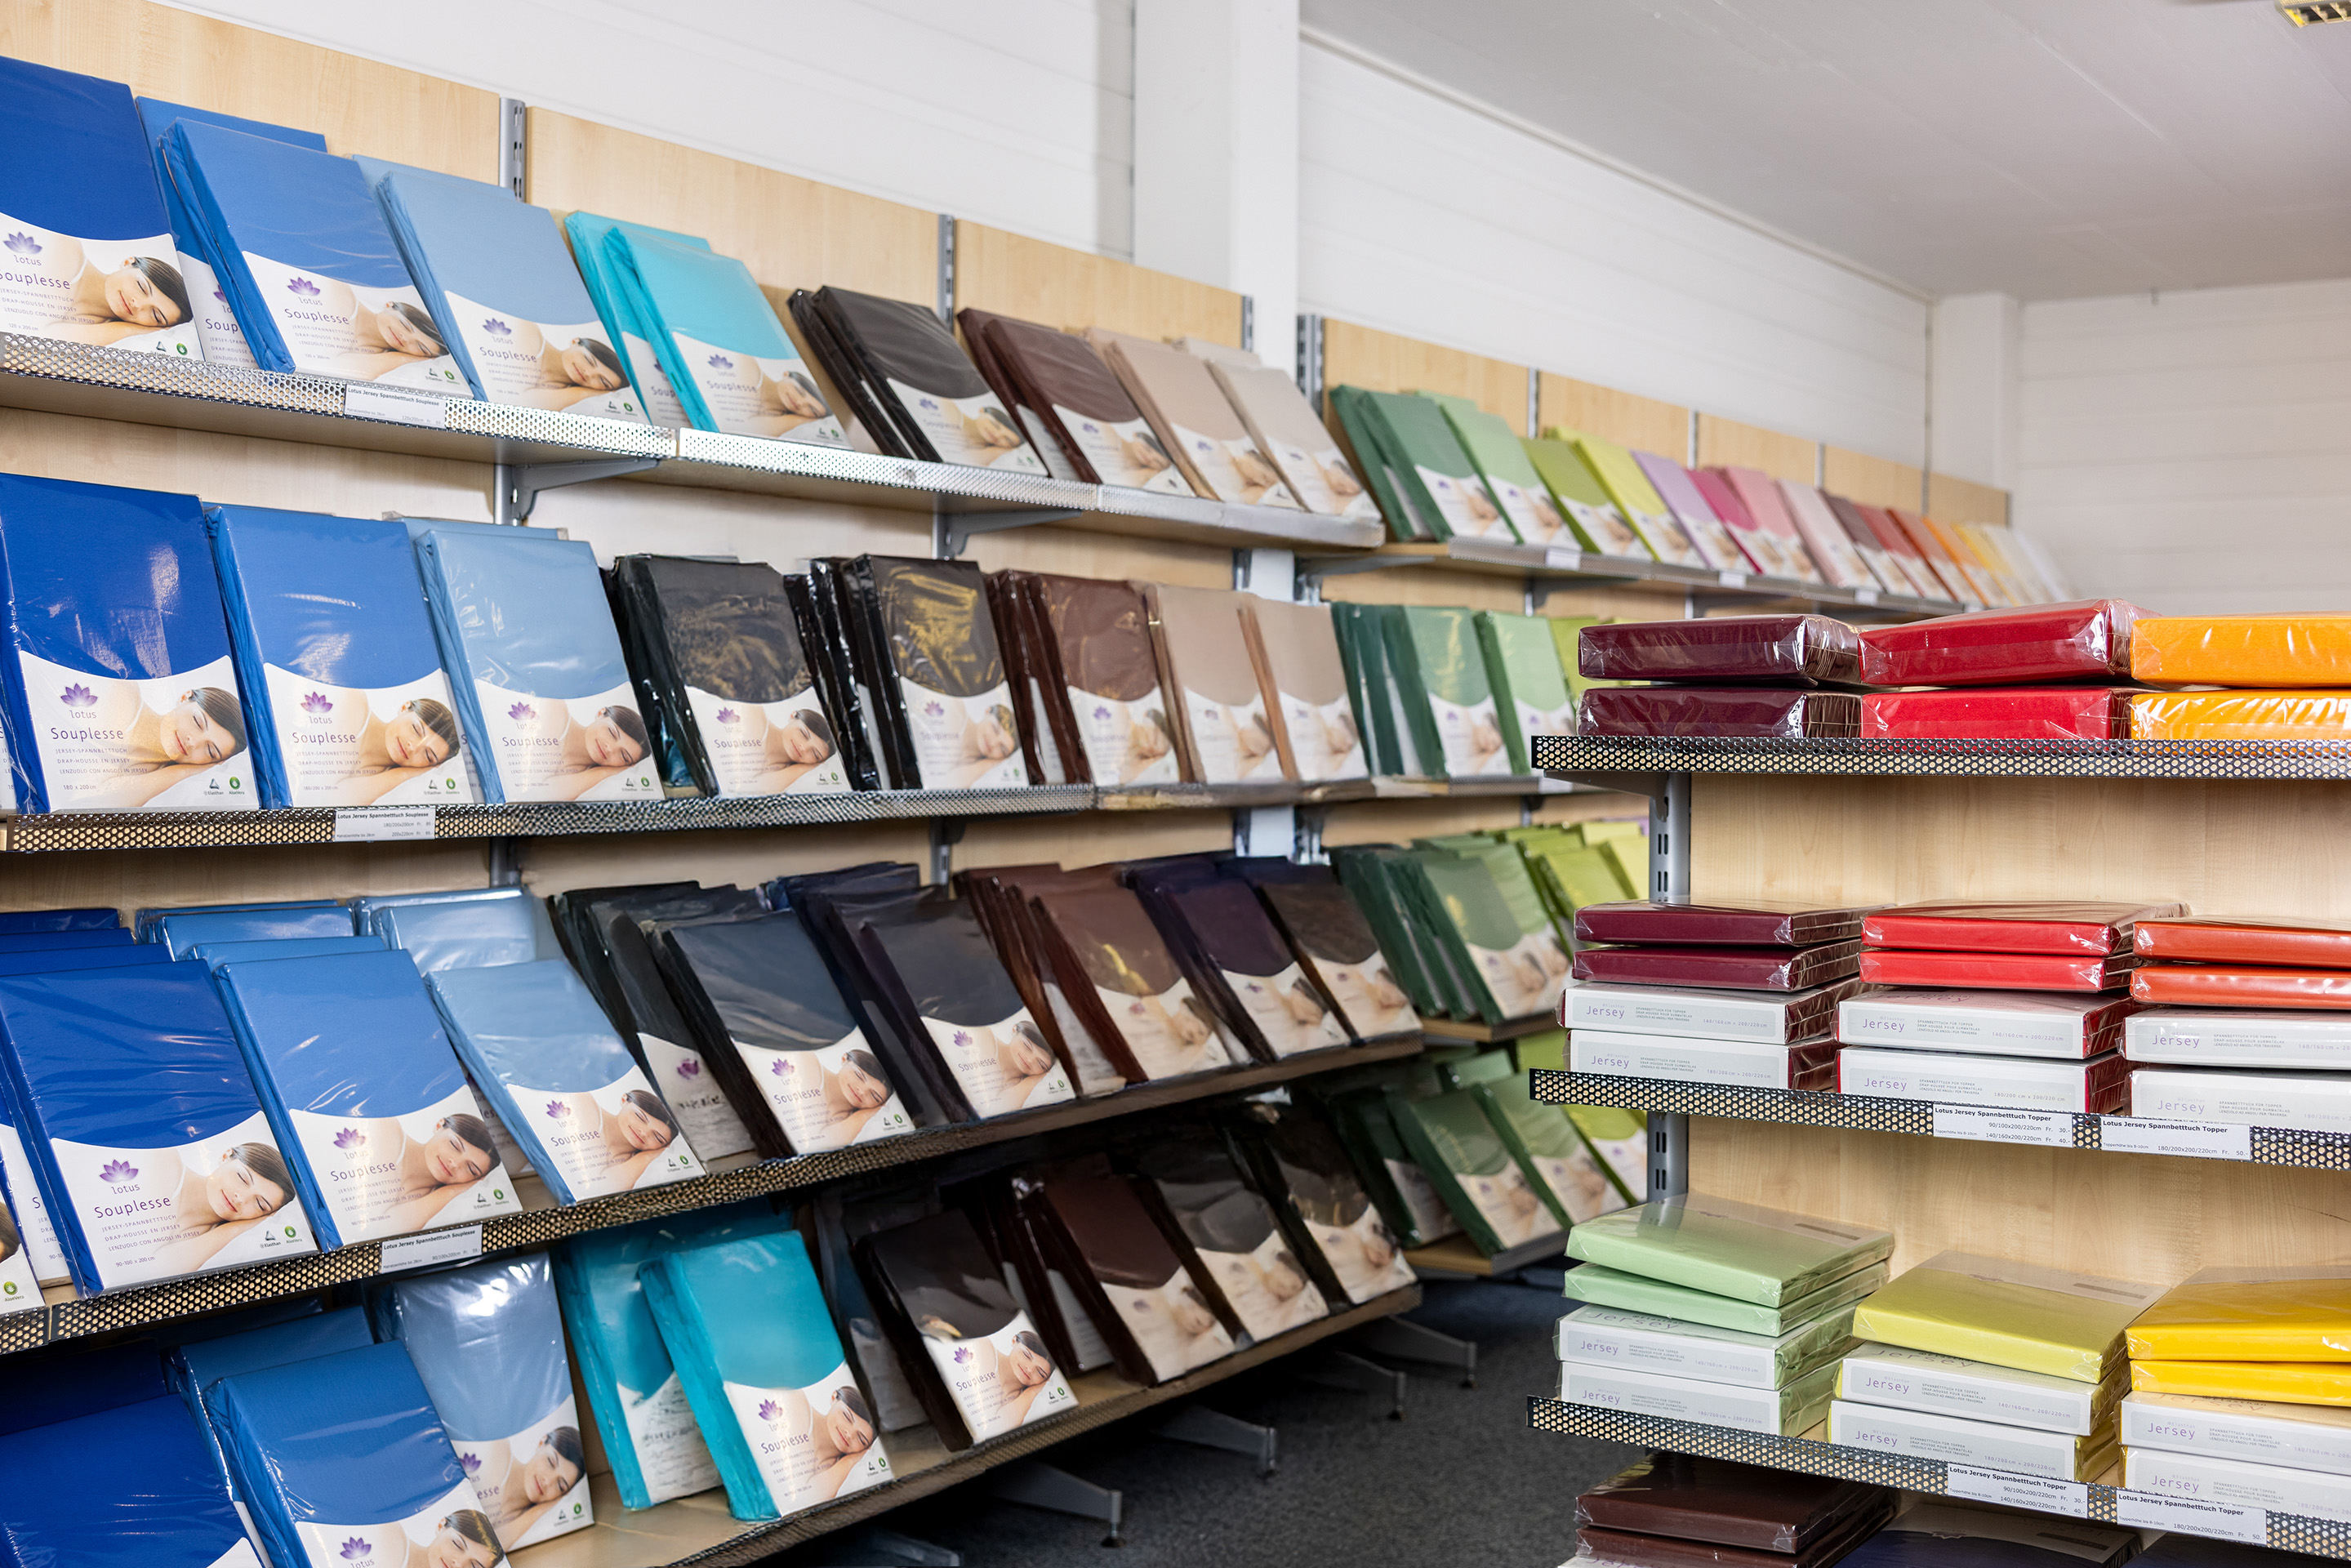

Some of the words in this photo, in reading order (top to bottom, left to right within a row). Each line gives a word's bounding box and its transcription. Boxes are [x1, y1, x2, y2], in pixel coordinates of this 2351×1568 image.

[13, 254, 42, 266] lotus
[2, 297, 45, 307] DRAP-HOUSSE
[298, 296, 323, 305] lotus
[284, 308, 350, 325] Souplesse
[479, 346, 537, 363] Souplesse
[363, 390, 379, 398] Jersey
[416, 399, 439, 408] Souplesse
[69, 710, 97, 719] lotus
[309, 716, 332, 724] lotus
[51, 727, 124, 742] Souplesse
[292, 732, 357, 746] Souplesse
[502, 737, 559, 748] Souplesse
[714, 739, 762, 749] Souplesse
[1586, 1005, 1625, 1019] Jersey
[1863, 1018, 1905, 1033] Jersey
[2153, 1035, 2200, 1049] Jersey
[958, 1058, 996, 1072] Souplesse
[1590, 1055, 1629, 1070] Jersey
[1864, 1078, 1907, 1092] Jersey
[774, 1089, 821, 1104] Souplesse
[2157, 1100, 2205, 1115] Jersey
[1978, 1111, 2026, 1120] Spannbetttuch
[1988, 1122, 2042, 1131] 90/100x200/220cm
[2148, 1123, 2200, 1131] Spannbetttuch
[550, 1130, 600, 1147] Souplesse
[1986, 1133, 2042, 1142] 140/160x200/220cm
[2157, 1146, 2218, 1154] 180/200x200/220cm
[330, 1162, 397, 1182] Souplesse
[111, 1183, 140, 1195] lotus
[94, 1197, 171, 1218] Souplesse
[102, 1214, 176, 1232] JERSEY-SPANNBETTTUCH
[105, 1229, 148, 1242] DRAP-HOUSSE
[160, 1223, 180, 1232] JERSEY
[452, 1230, 475, 1238] Souplesse
[109, 1241, 138, 1251] LENZUOLO
[153, 1236, 174, 1244] ANGOLI
[183, 1231, 200, 1239] JERSEY
[115, 1259, 133, 1267] 90-100
[1587, 1312, 1679, 1330] Jersey
[1581, 1341, 1619, 1356] Jersey
[1871, 1350, 1974, 1368] Jersey
[956, 1372, 996, 1391] Souplesse
[1866, 1378, 1909, 1394] Jersey
[1583, 1390, 1620, 1405] Jersey
[1855, 1431, 1898, 1447] Jersey
[2148, 1423, 2195, 1440] Jersey
[760, 1433, 809, 1454] Souplesse
[1949, 1467, 1967, 1475] Lotus
[1969, 1470, 1991, 1479] Jersey
[1993, 1473, 2041, 1486] Spannbetttuch
[2043, 1481, 2067, 1490] Topper
[2152, 1476, 2199, 1494] Jersey
[2003, 1486, 2056, 1499] 90/100x200/220cm
[2001, 1496, 2056, 1510] 140/160x200/220cm
[2119, 1494, 2138, 1502] Lotus
[2139, 1497, 2162, 1505] Jersey
[2164, 1500, 2216, 1512] Spannbetttuch
[2219, 1507, 2244, 1516] Topper
[2174, 1523, 2233, 1536] 180/200x200/220cm
